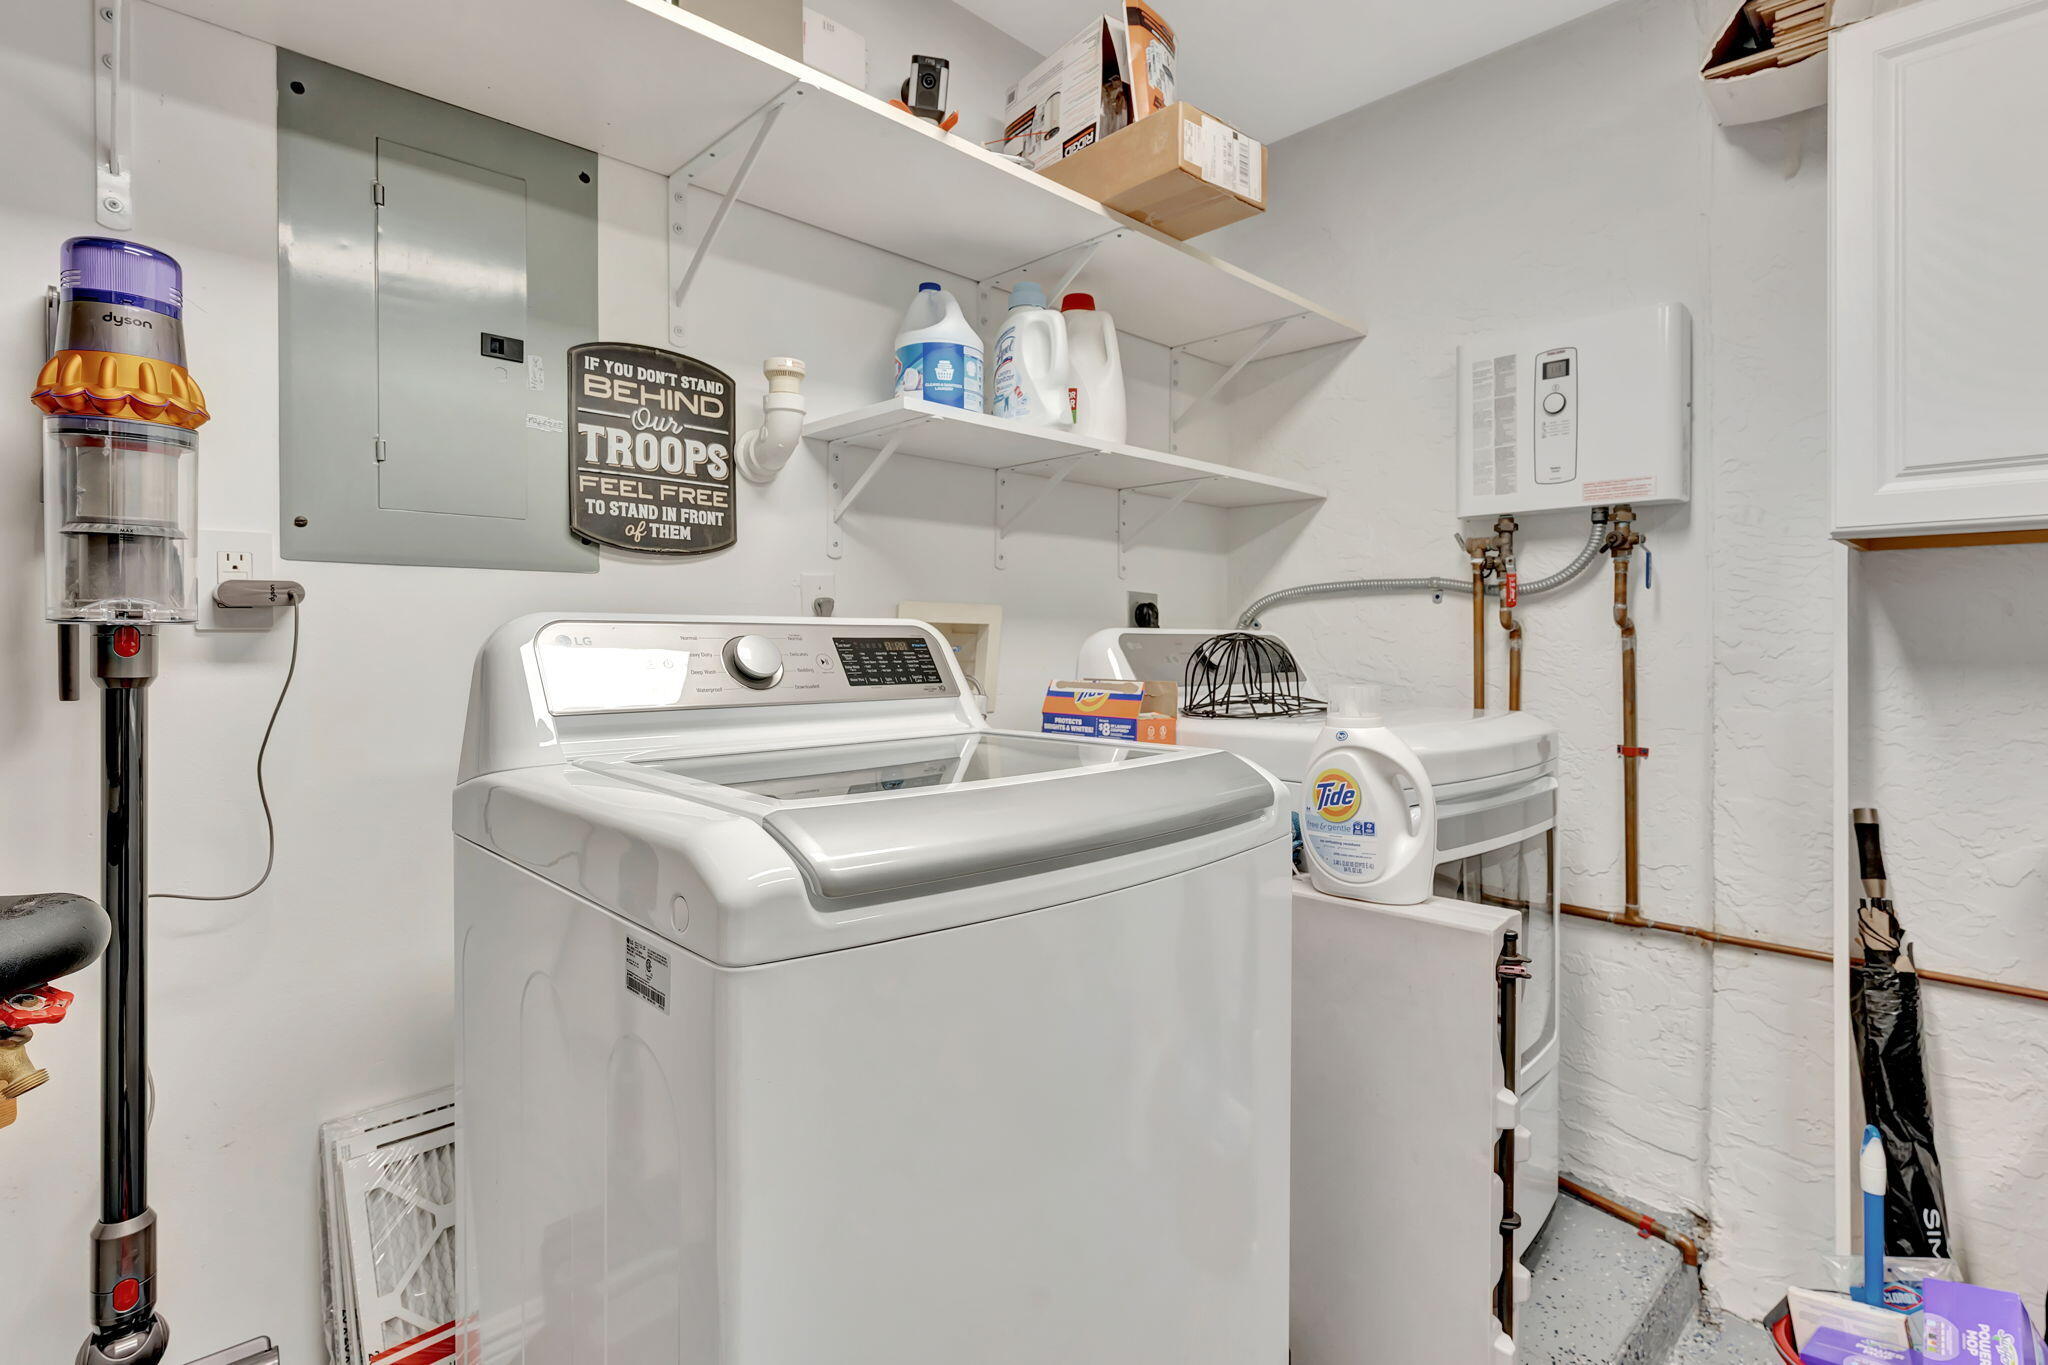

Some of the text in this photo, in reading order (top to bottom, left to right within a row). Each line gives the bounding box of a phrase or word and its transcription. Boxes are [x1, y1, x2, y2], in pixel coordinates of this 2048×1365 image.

[102, 312, 153, 329] dyson
[584, 355, 724, 396] IF YOU DON'T STAND
[583, 374, 724, 418] BEHIND
[631, 407, 684, 434] Our
[578, 422, 729, 480] TROOPS
[579, 475, 729, 508] FEEL FREE
[585, 499, 724, 526] TO STAND IN FRONT
[625, 521, 691, 543] of THEM
[574, 637, 592, 646] LG
[1316, 782, 1356, 811] Tide
[1327, 823, 1351, 833] gentle
[1966, 1330, 1979, 1356] MOP
